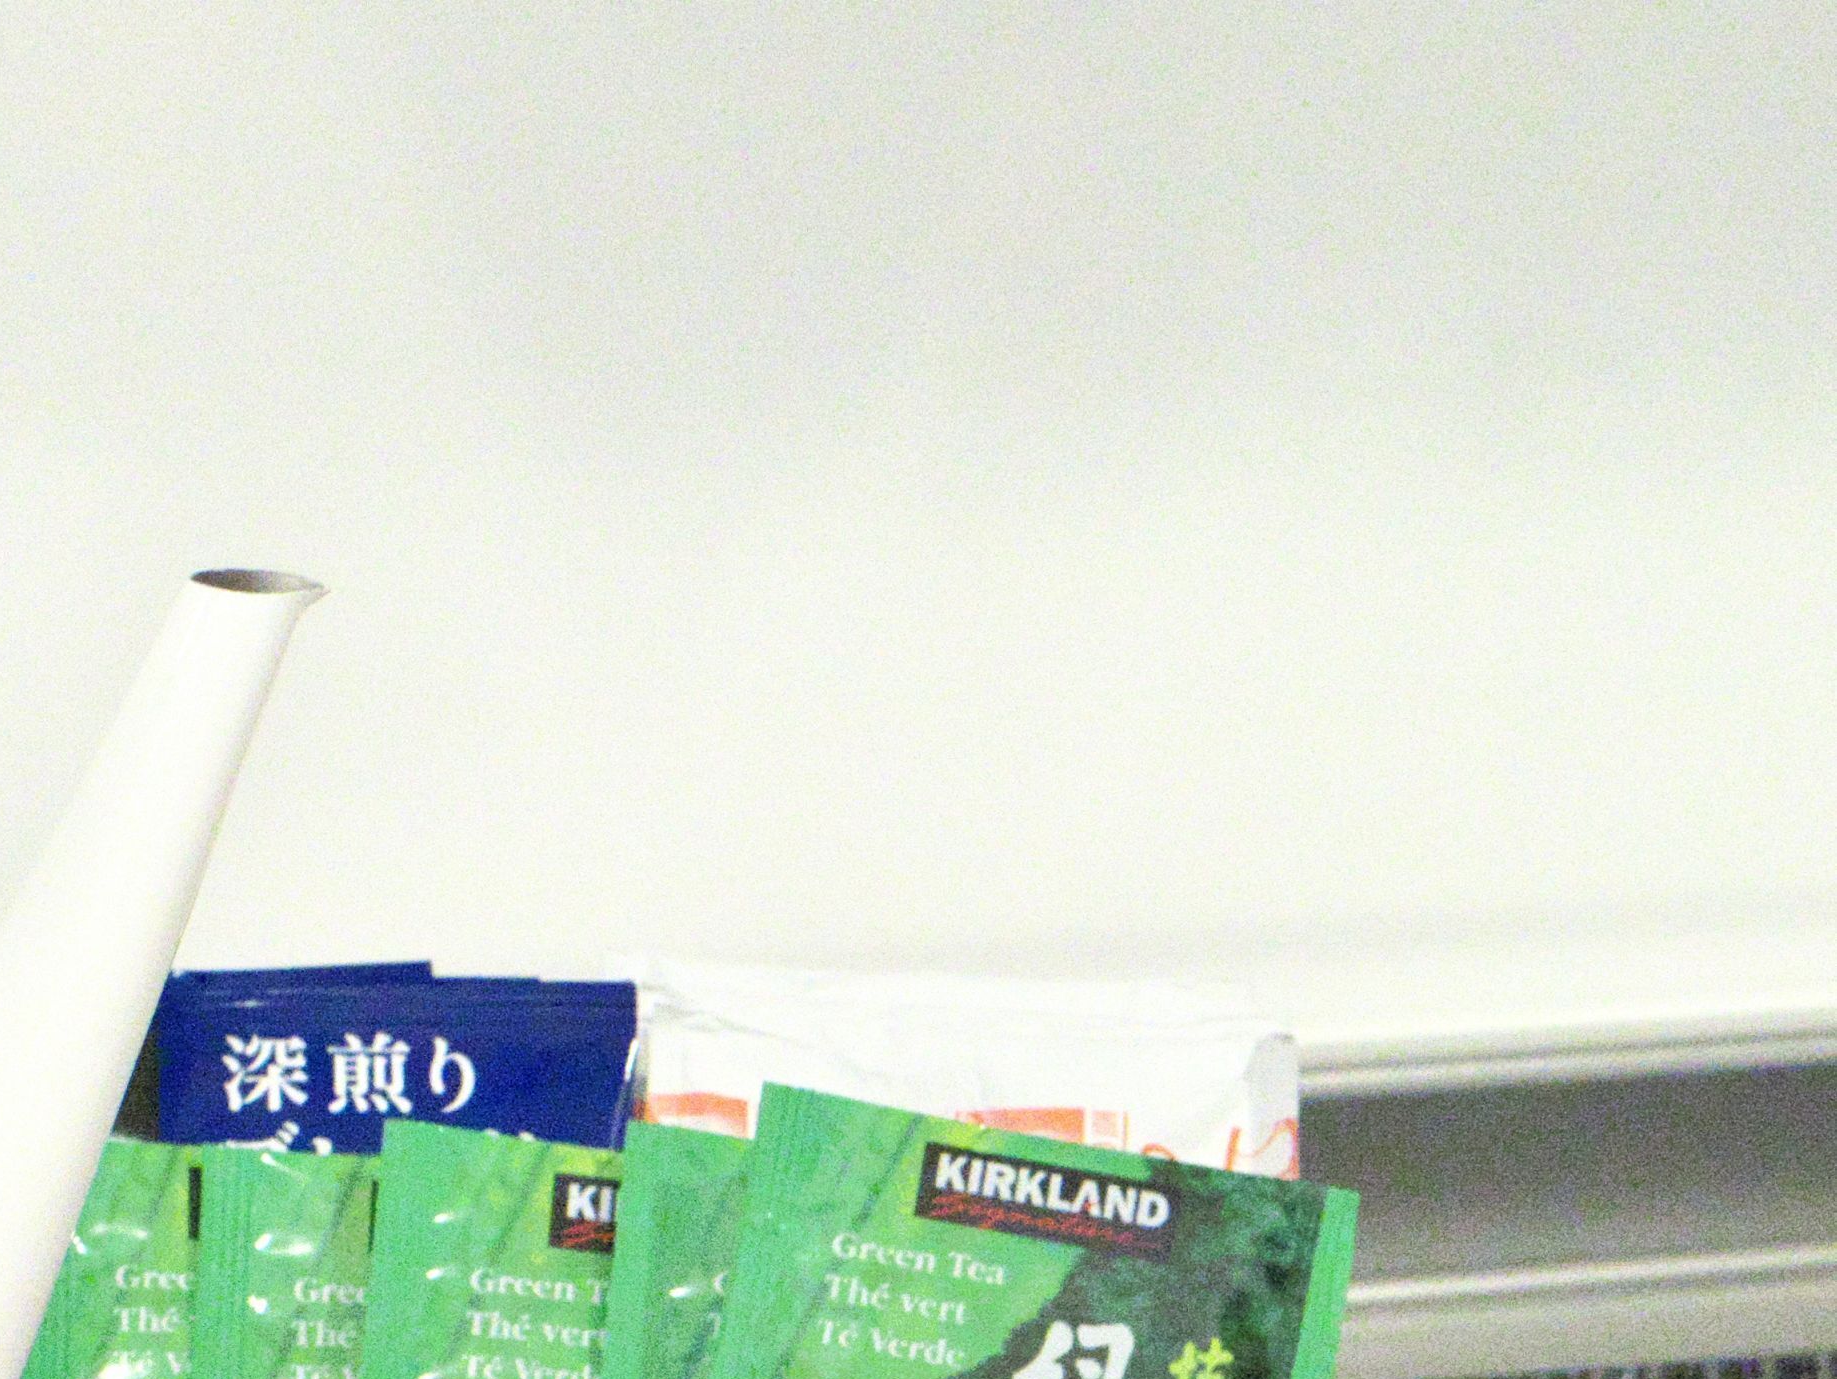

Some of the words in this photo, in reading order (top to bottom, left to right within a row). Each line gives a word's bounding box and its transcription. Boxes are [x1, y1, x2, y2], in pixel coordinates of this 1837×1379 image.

[221, 1030, 476, 1115] 深煎り
[565, 1181, 614, 1224] KI
[934, 1152, 1172, 1229] KIRKLAND
[831, 1232, 937, 1275] Green
[948, 1251, 1006, 1286] Tea
[469, 1267, 576, 1303] Green
[824, 1273, 891, 1311] Thé
[900, 1291, 968, 1326] vert
[113, 1305, 180, 1334] Thé
[466, 1310, 531, 1342] Thé
[817, 1318, 859, 1350] Té
[869, 1327, 965, 1369] Verde
